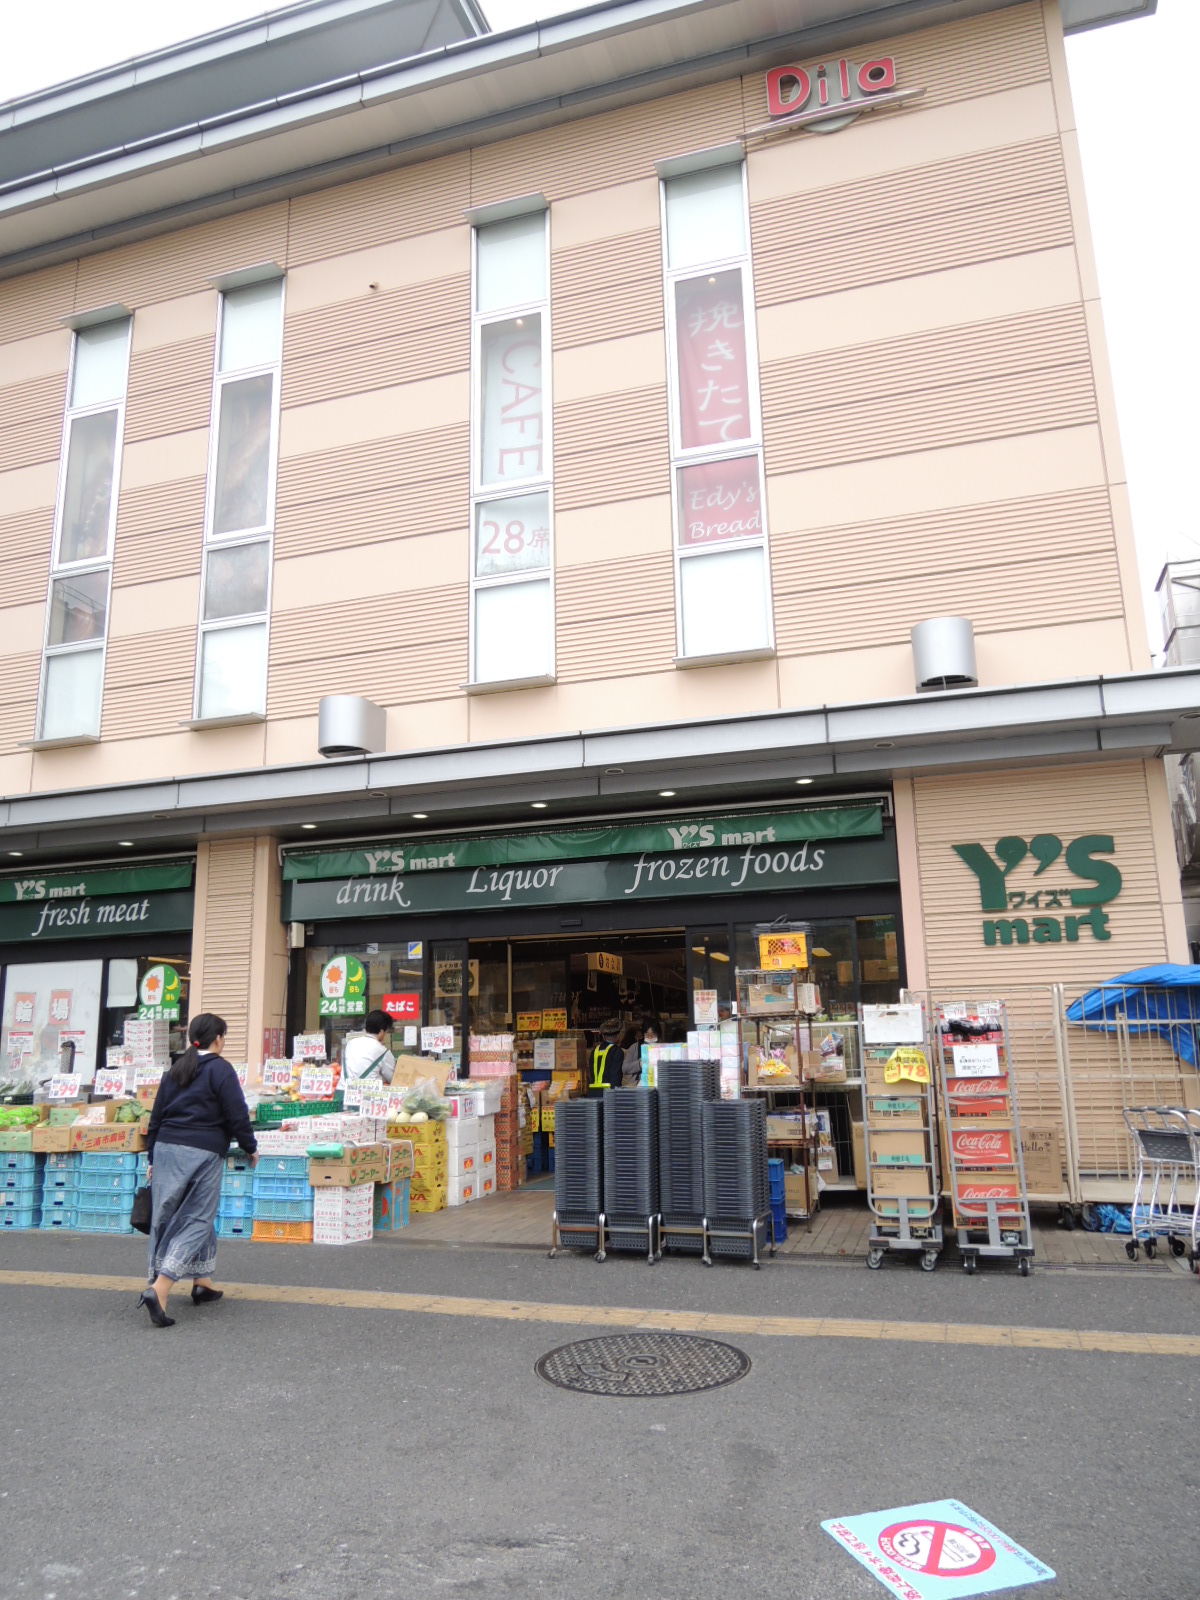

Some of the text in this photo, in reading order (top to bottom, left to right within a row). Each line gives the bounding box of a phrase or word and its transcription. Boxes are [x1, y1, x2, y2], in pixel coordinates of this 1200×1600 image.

[766, 56, 897, 115] Dila
[498, 339, 544, 476] CAFE
[689, 481, 760, 510] Edy's
[689, 510, 761, 539] Bread
[721, 826, 776, 846] mart
[410, 852, 456, 870] mart
[624, 838, 826, 894] frozen foods
[49, 882, 86, 897] mart
[336, 873, 411, 908] drink
[465, 864, 564, 901] Liquor
[1008, 889, 1071, 909] ワイズ
[31, 898, 151, 937] fresh meat
[982, 906, 1113, 947] mart
[386, 1001, 415, 1012] たばこ
[304, 1045, 324, 1055] 399
[433, 1036, 452, 1048] 299
[271, 1072, 291, 1083] 100
[896, 1065, 927, 1078] 178
[58, 1084, 78, 1096] 99
[104, 1081, 123, 1093] 99
[310, 1080, 332, 1092] 129
[370, 1102, 388, 1116] 139
[956, 1133, 1004, 1150] Coca-Cola
